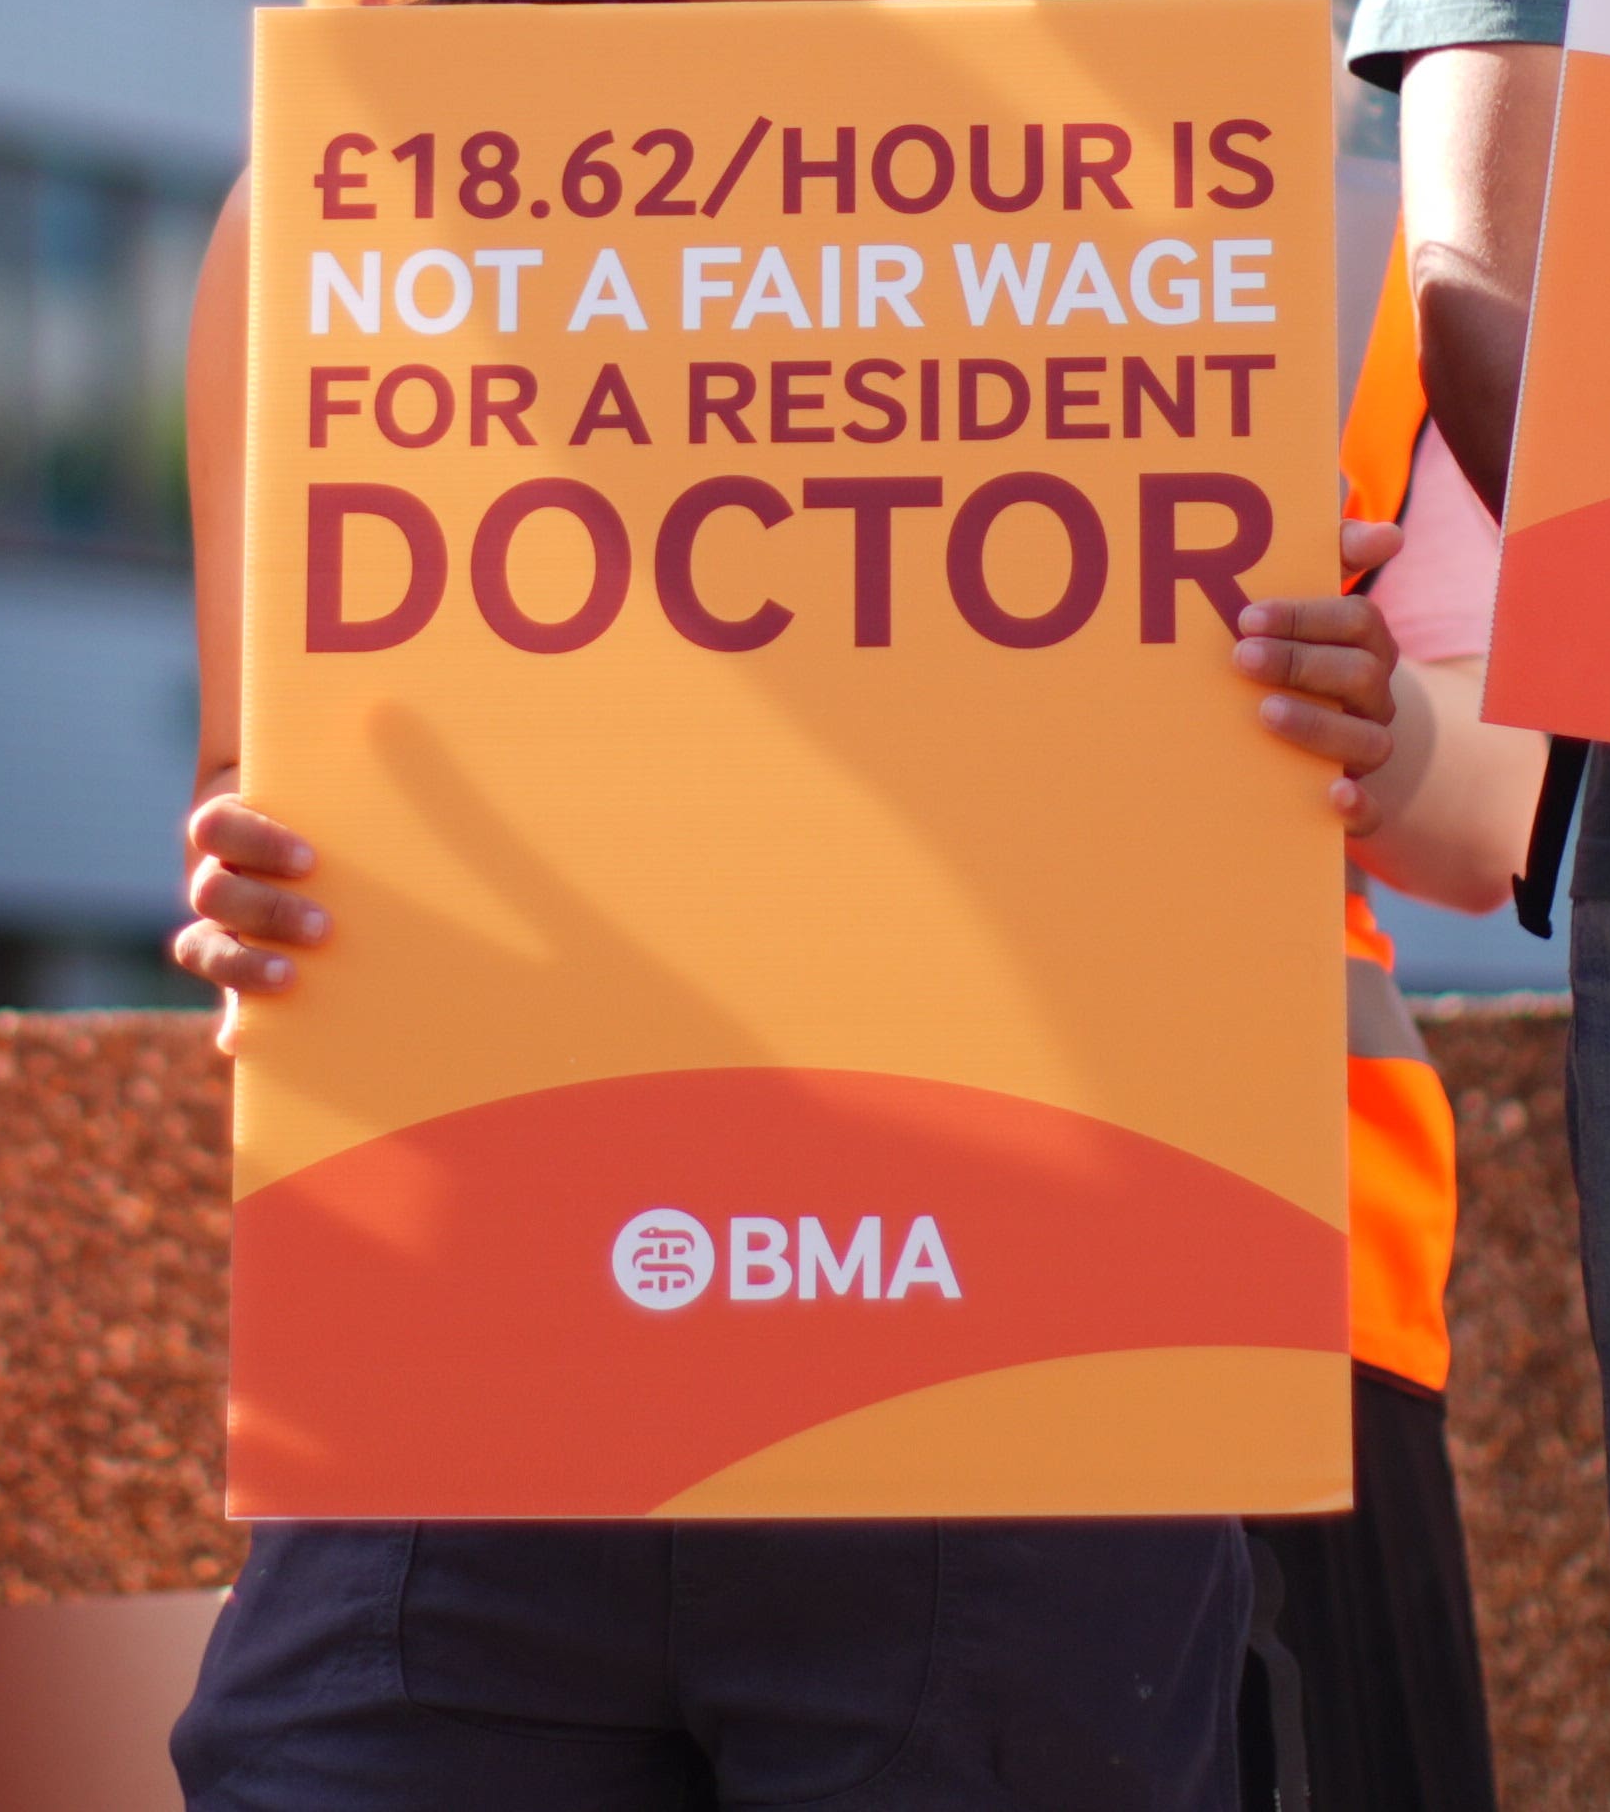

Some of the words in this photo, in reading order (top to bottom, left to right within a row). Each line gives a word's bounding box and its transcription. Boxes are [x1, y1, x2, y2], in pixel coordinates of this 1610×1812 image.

[314, 115, 1133, 220] £18.62/HOUR
[1174, 118, 1275, 210] IS
[310, 249, 543, 335] NOT
[567, 247, 649, 330] A
[681, 244, 924, 330] FAIR
[953, 238, 1277, 326] WAGE
[308, 363, 539, 449] FOR
[569, 362, 652, 446] A
[689, 353, 1277, 445] RESIDENT
[304, 471, 1274, 655] DOCTOR
[728, 1214, 963, 1302] BMA
